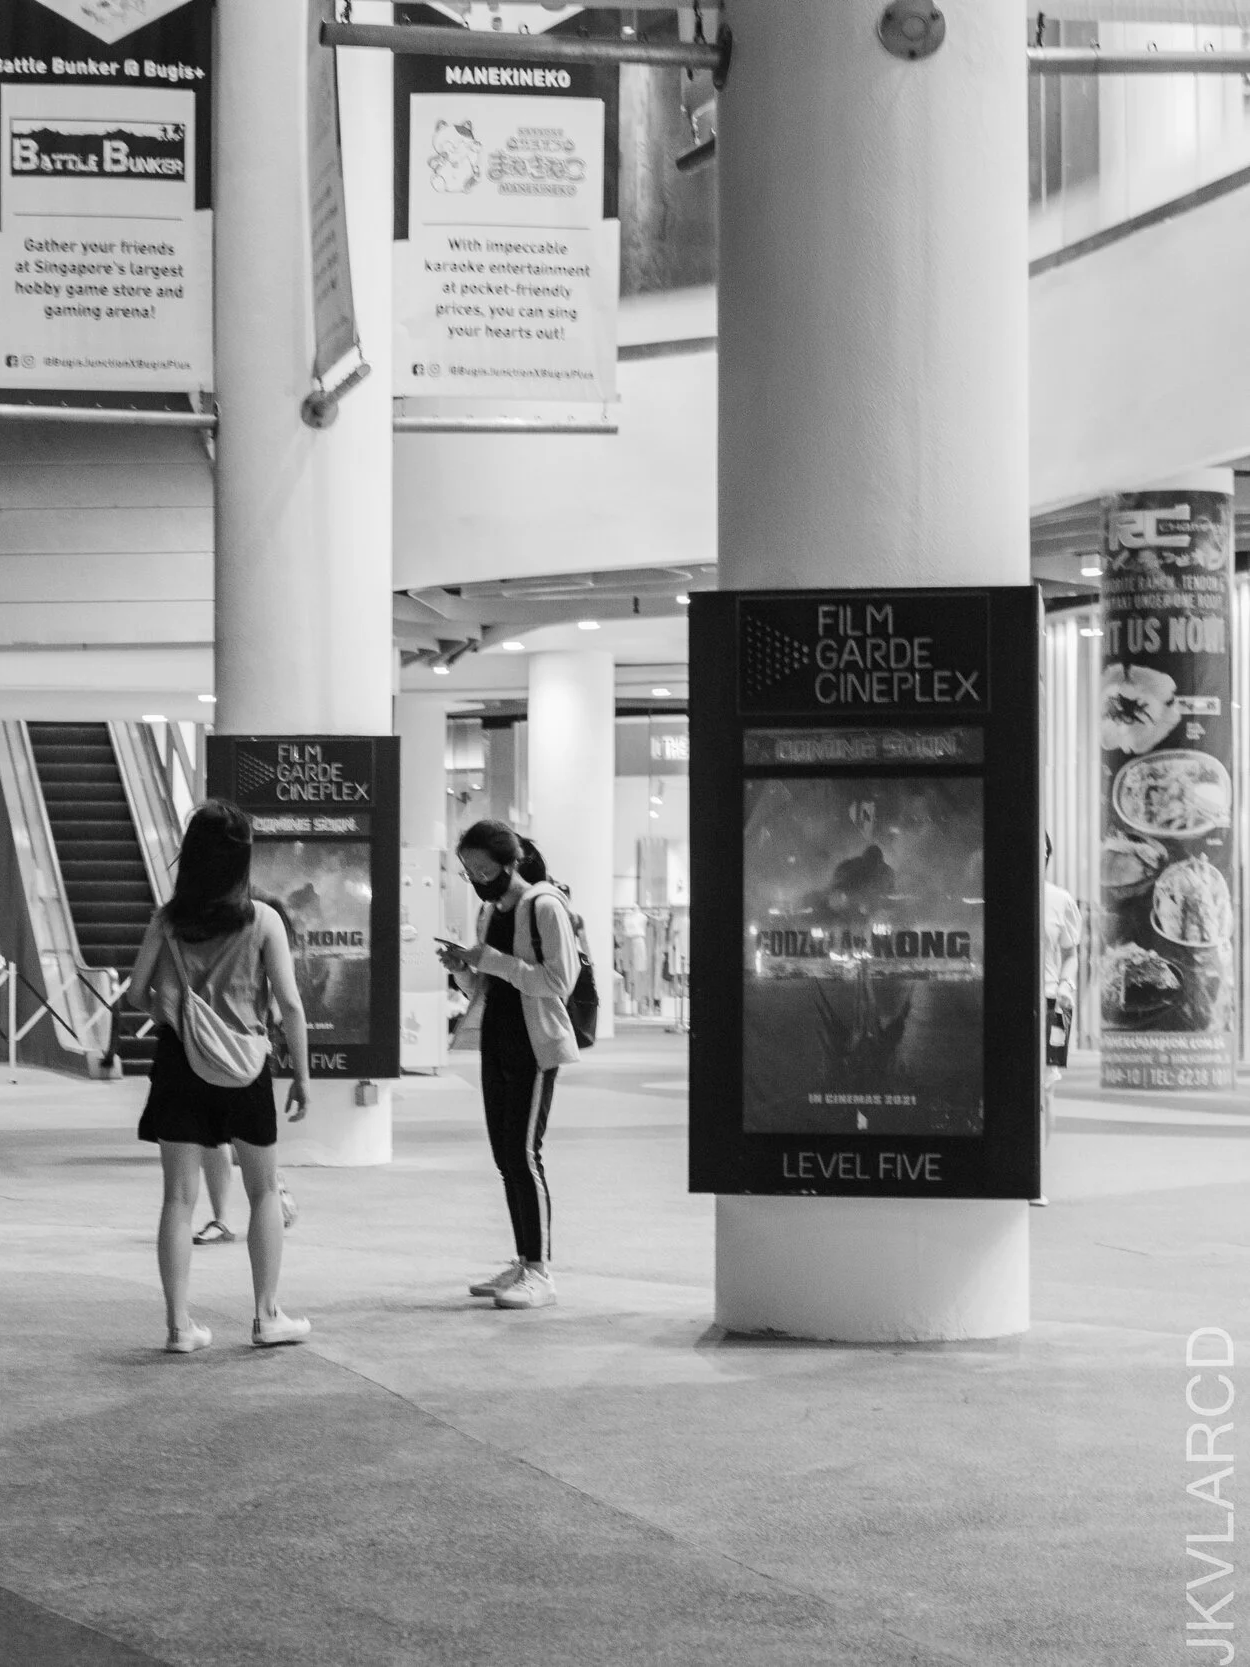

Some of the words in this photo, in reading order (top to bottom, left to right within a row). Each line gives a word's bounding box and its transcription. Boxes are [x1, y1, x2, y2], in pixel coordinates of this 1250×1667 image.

[52, 56, 120, 76] Bunker
[144, 60, 205, 82] Bugis+
[445, 65, 571, 88] MANEKINEKO
[24, 237, 77, 252] Gather
[81, 241, 116, 256] your
[121, 240, 175, 256] friends
[448, 238, 482, 252] With
[486, 239, 568, 256] impeccable
[15, 261, 30, 273] at
[35, 260, 126, 277] Singapore's
[130, 262, 184, 279] largest
[424, 259, 485, 273] karaoke
[489, 262, 591, 277] entertainment
[15, 281, 60, 298] hobby
[66, 285, 108, 299] game
[113, 284, 152, 298] store
[156, 284, 184, 299] and
[442, 282, 456, 294] at
[460, 281, 572, 300] pocket-friendly
[44, 304, 102, 321] gaming
[105, 304, 156, 320] arena!
[436, 303, 485, 318] prices,
[489, 306, 514, 319] you
[519, 306, 543, 318] can
[548, 306, 578, 322] sing
[448, 326, 482, 339] your
[485, 325, 533, 339] hearts
[536, 327, 565, 340] out!
[818, 604, 894, 637] FILM
[1127, 616, 1161, 654] US
[816, 638, 934, 670] GARDE
[815, 670, 981, 703] CINEPLEX
[278, 744, 322, 763] FILM
[277, 764, 343, 782] GARDE
[277, 781, 370, 801] CINEPLEX
[308, 930, 363, 947] KONG
[871, 931, 971, 959] KONG
[311, 1053, 348, 1070] FIVE
[825, 1093, 881, 1104] CINEMAS
[783, 1152, 870, 1180] LEVEL
[879, 1153, 942, 1181] FIVE
